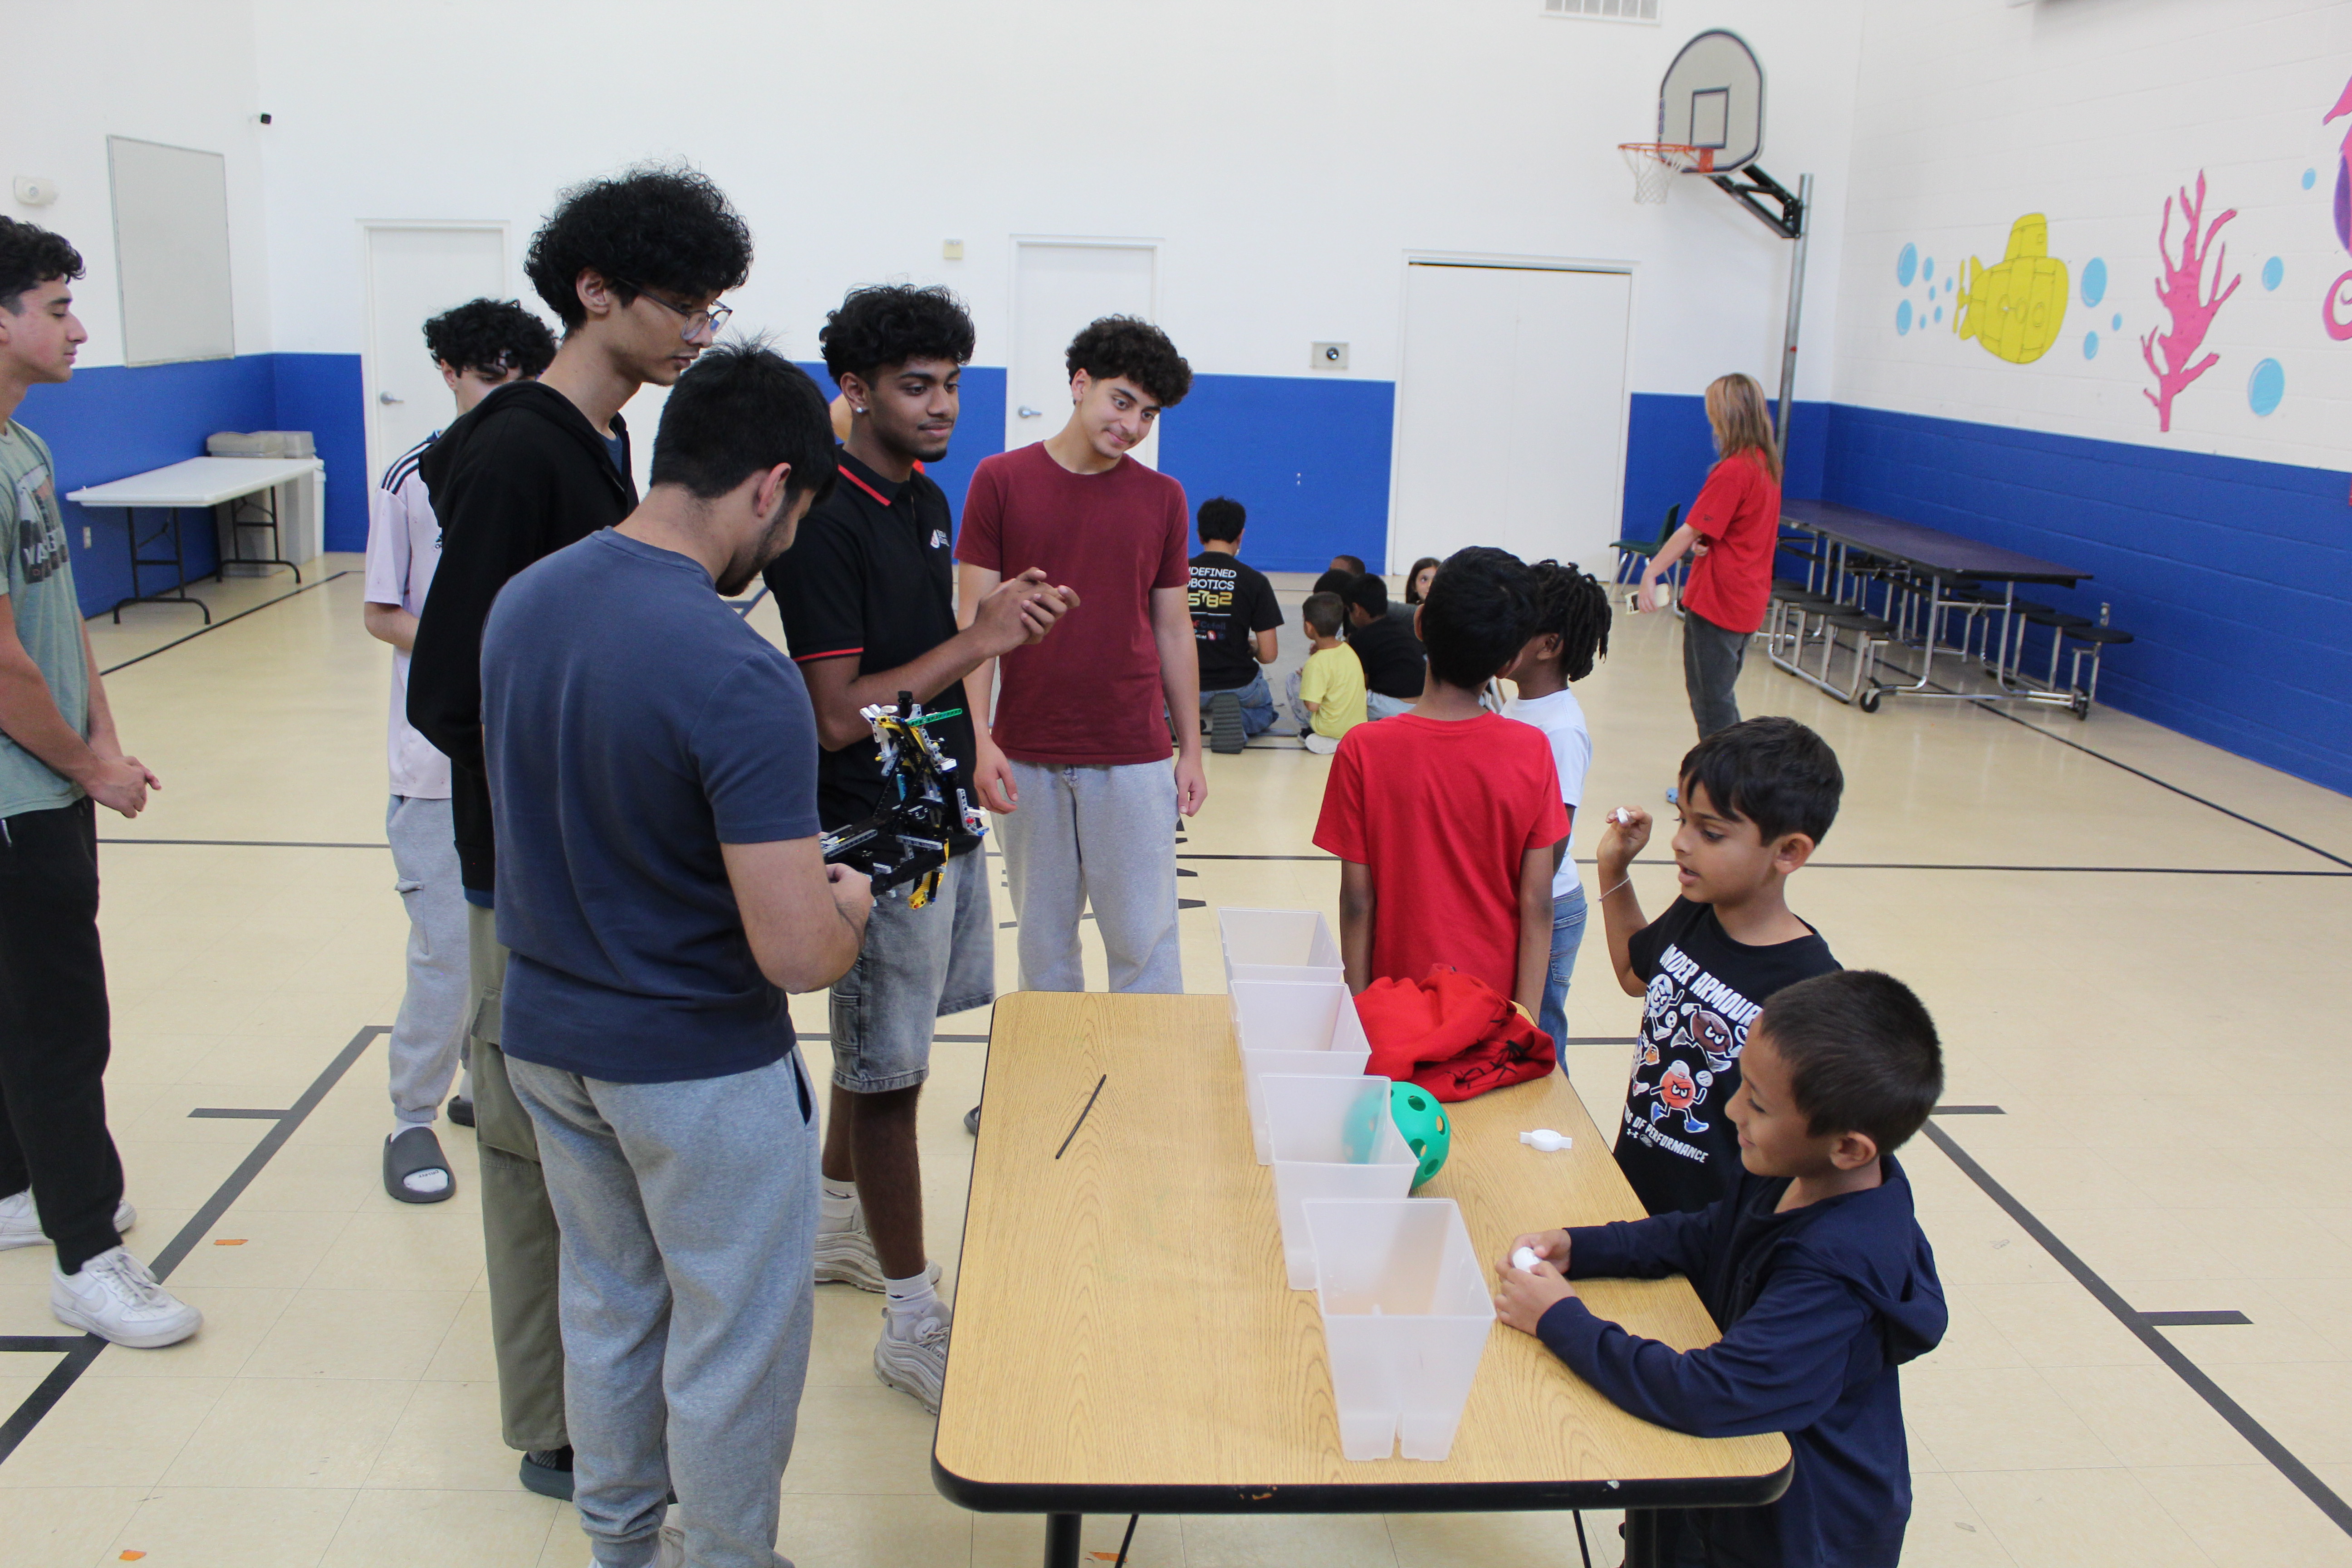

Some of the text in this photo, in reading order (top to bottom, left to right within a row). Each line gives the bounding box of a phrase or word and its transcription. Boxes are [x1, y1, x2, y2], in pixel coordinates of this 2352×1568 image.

[1189, 566, 1237, 578] DEFINED
[1188, 590, 1233, 608] 5782
[1689, 971, 1764, 1026] ARMOUR
[1632, 1117, 1709, 1163] OF PERFORMANCE
